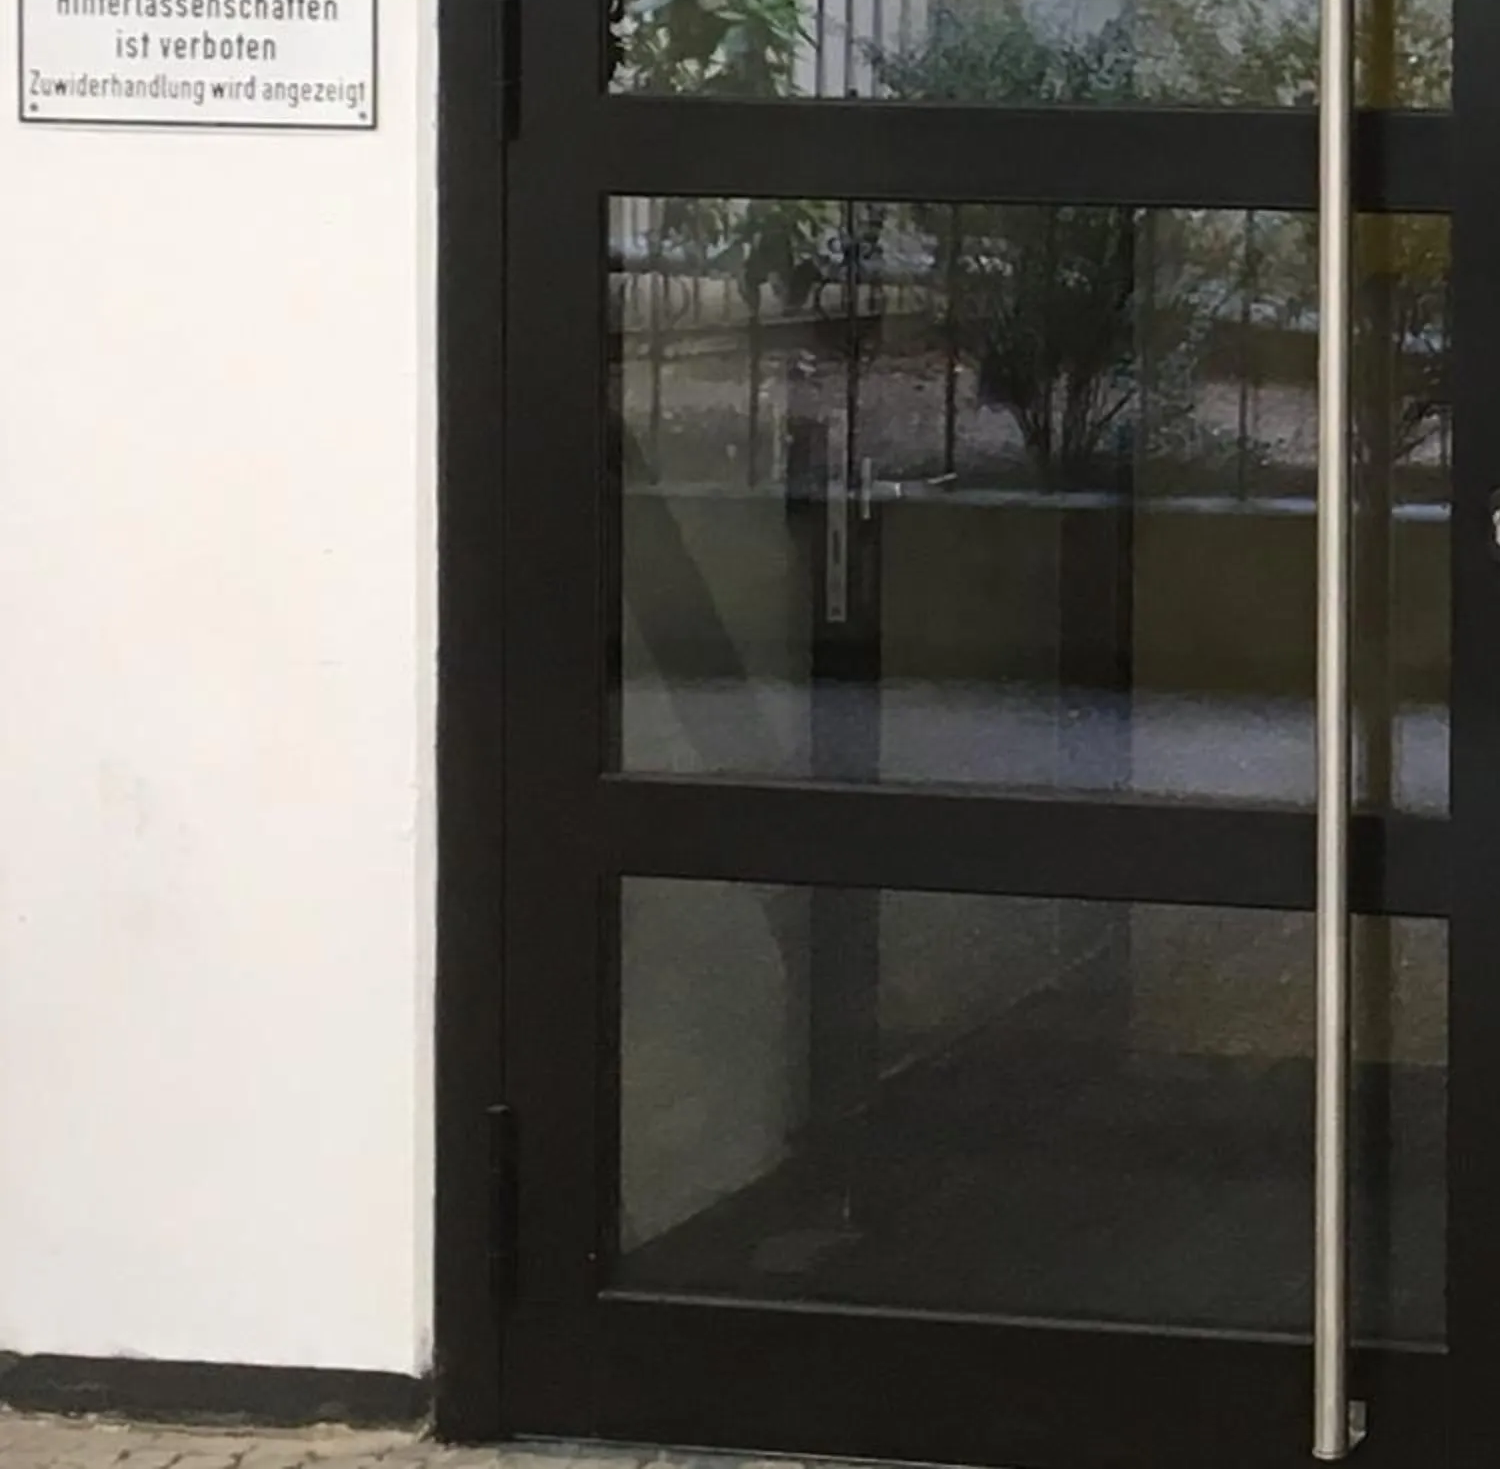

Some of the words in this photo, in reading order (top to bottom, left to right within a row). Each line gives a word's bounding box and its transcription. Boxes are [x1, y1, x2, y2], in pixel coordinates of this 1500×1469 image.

[117, 30, 149, 58] ist
[160, 31, 275, 60] verboten
[30, 70, 204, 106] Zuwiderhandlung
[212, 77, 255, 99] wird
[263, 78, 364, 108] angezeigt
